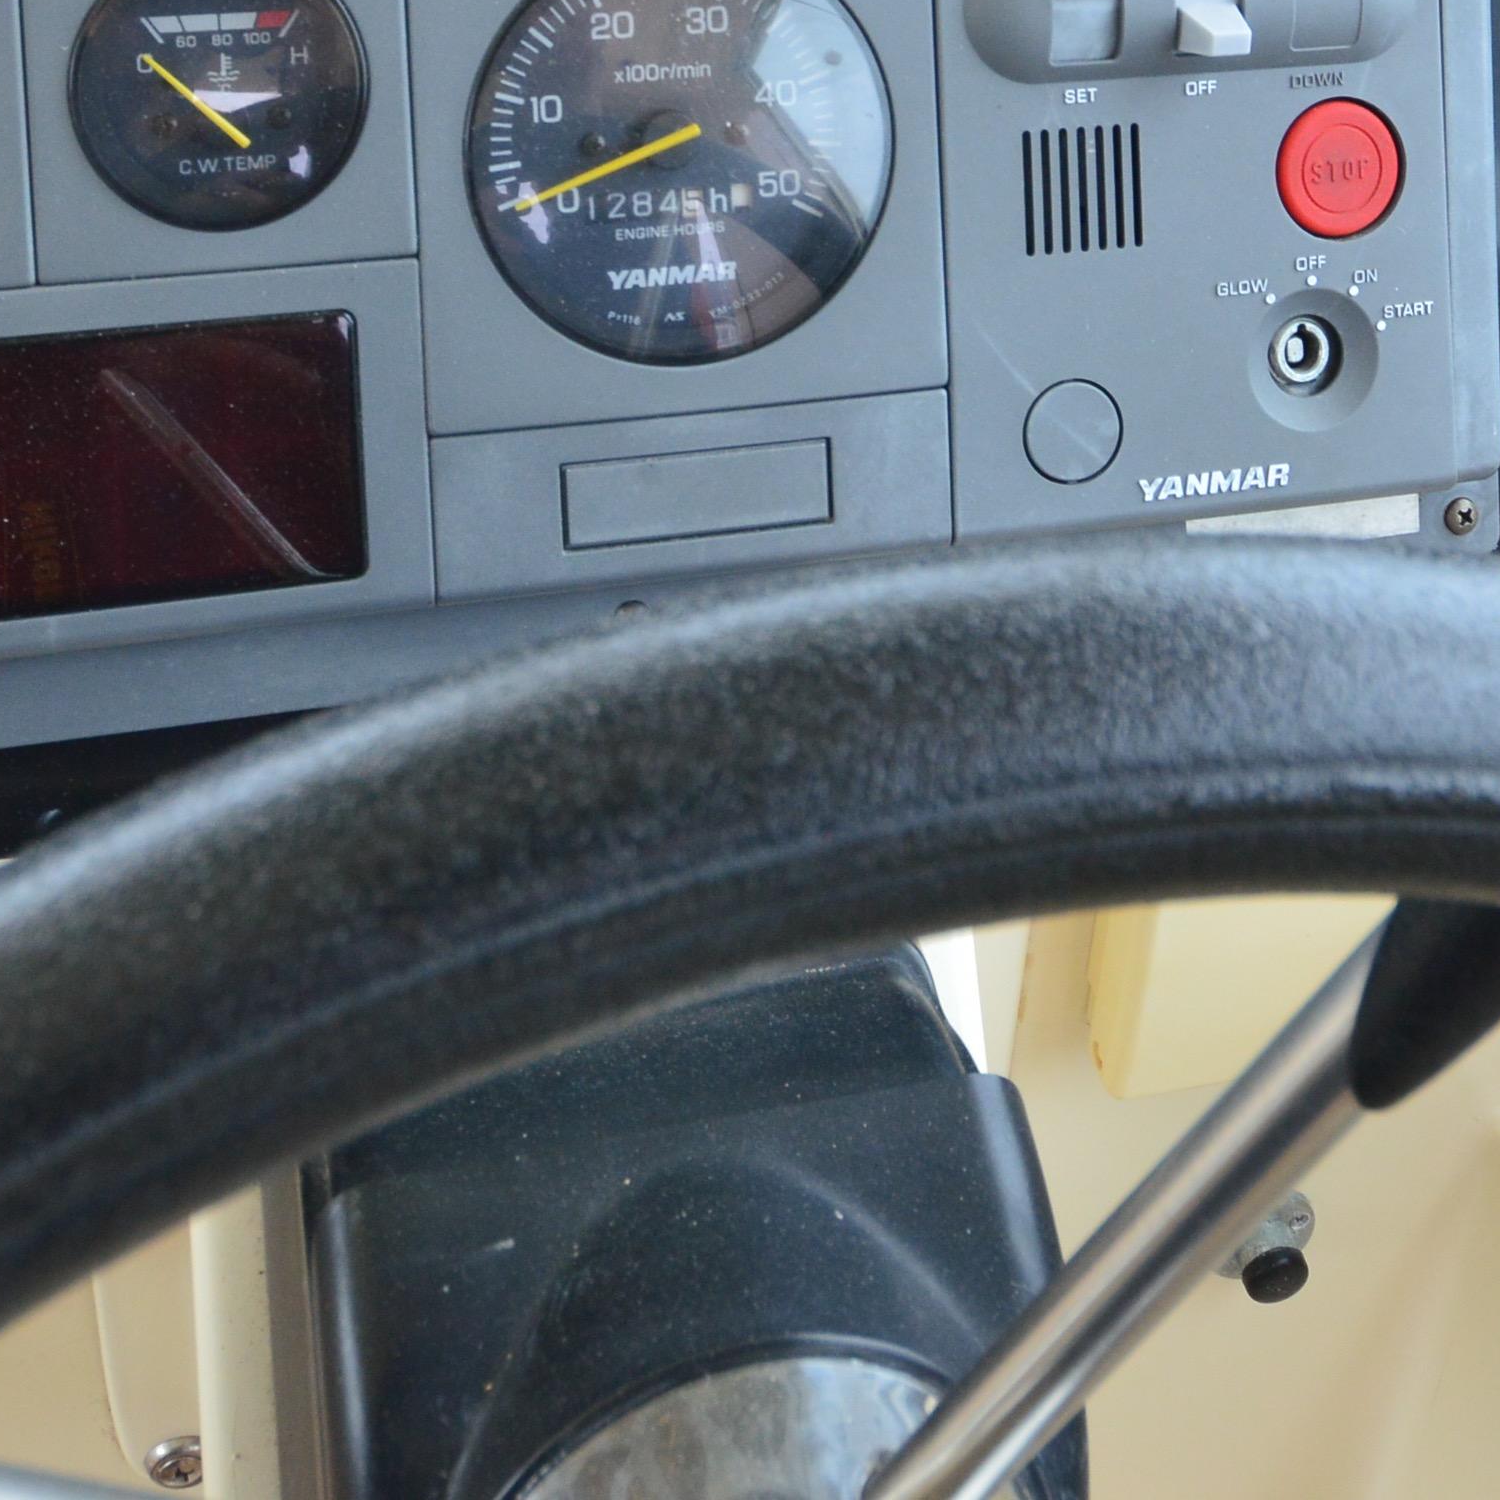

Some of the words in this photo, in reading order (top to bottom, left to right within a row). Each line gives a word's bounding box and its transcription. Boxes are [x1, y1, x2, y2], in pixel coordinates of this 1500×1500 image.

[590, 11, 634, 40] 20
[685, 5, 729, 34] 30
[175, 35, 197, 48] 60
[211, 33, 233, 47] 80
[242, 31, 271, 45] 100
[289, 45, 309, 66] H
[1185, 80, 1217, 96] OFF
[1290, 72, 1345, 88] DOWN
[755, 80, 797, 107] 40
[1064, 88, 1098, 104] SET
[530, 95, 563, 123] 10
[1309, 158, 1368, 185] STOP
[758, 169, 800, 197] 50
[615, 225, 670, 242] ENGINE
[673, 220, 725, 235] HOURS
[1295, 255, 1327, 271] OFF
[606, 260, 737, 291] YANMAR
[1353, 269, 1379, 284] ON
[1217, 279, 1269, 297] GLOW
[1384, 301, 1434, 318] START
[1137, 463, 1290, 502] YANMAR
